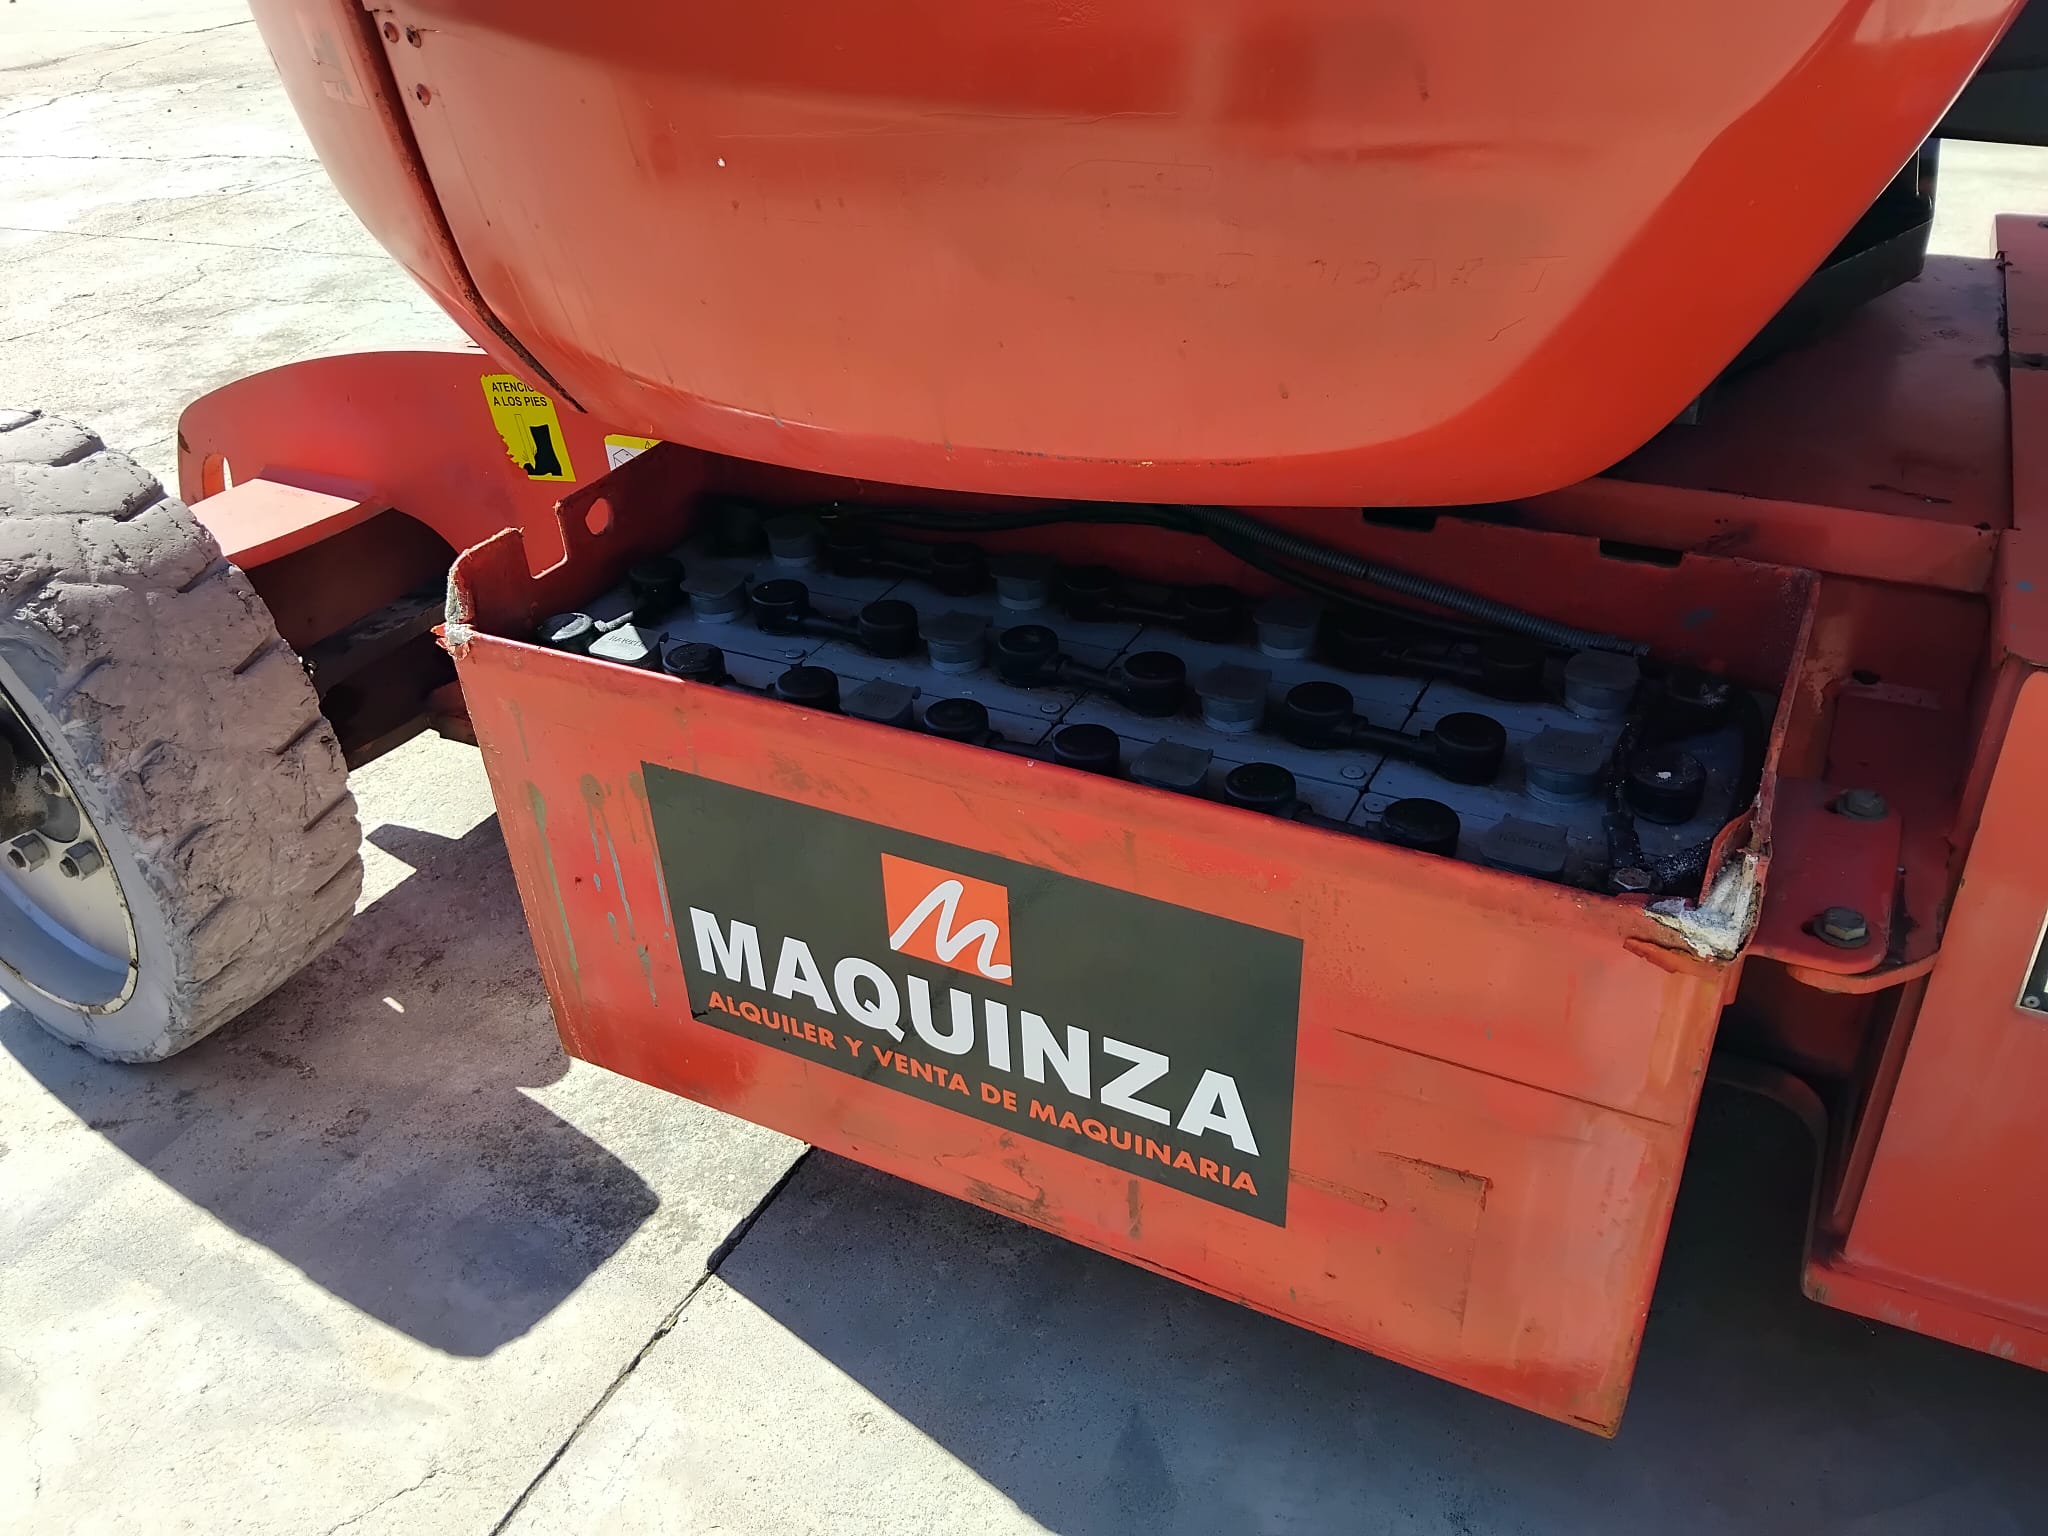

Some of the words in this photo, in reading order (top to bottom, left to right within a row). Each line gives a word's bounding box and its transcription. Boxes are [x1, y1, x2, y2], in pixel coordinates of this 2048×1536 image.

[493, 396, 502, 407] A
[502, 396, 523, 407] LOS
[524, 396, 548, 407] PIES
[689, 906, 1260, 1157] MAQUINZA
[709, 992, 836, 1050] ALQUILER
[844, 1036, 863, 1057] Y
[873, 1045, 970, 1096] VENTA
[980, 1082, 1018, 1113] DE
[1029, 1100, 1257, 1196] MAQUINARIA
